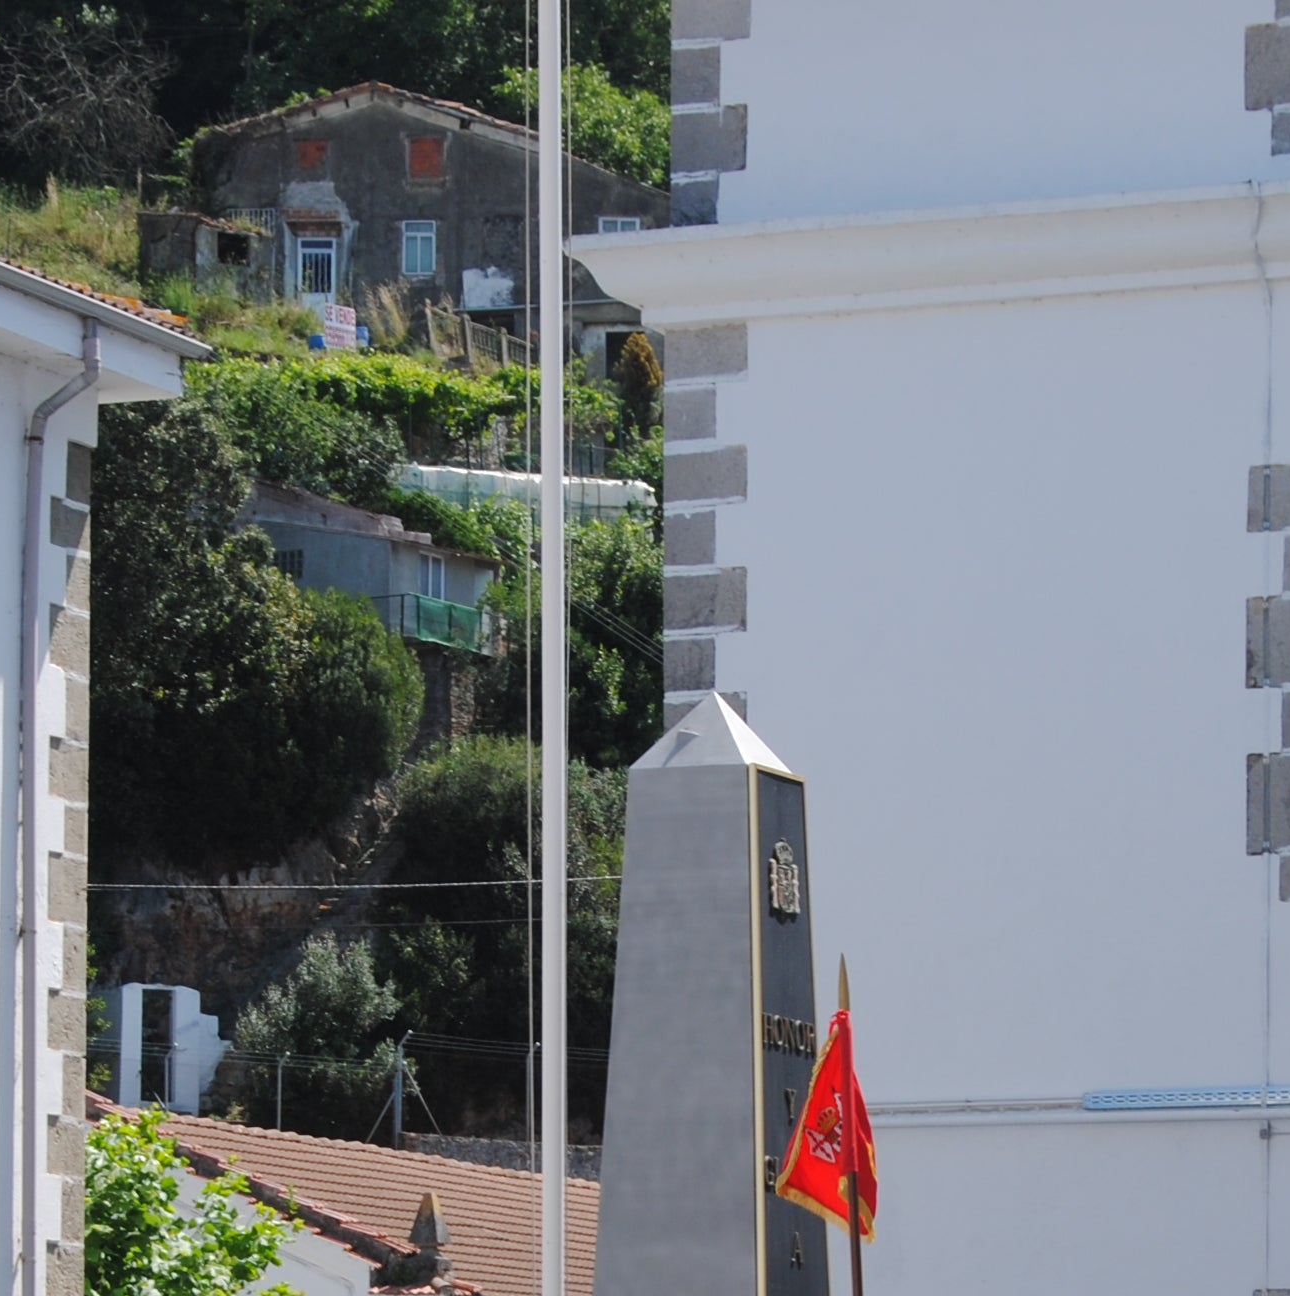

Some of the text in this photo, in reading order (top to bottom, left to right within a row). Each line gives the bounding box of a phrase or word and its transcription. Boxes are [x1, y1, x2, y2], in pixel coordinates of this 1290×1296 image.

[763, 1013, 815, 1053] HONOR
[785, 1088, 797, 1121] Y
[790, 1231, 804, 1264] A
